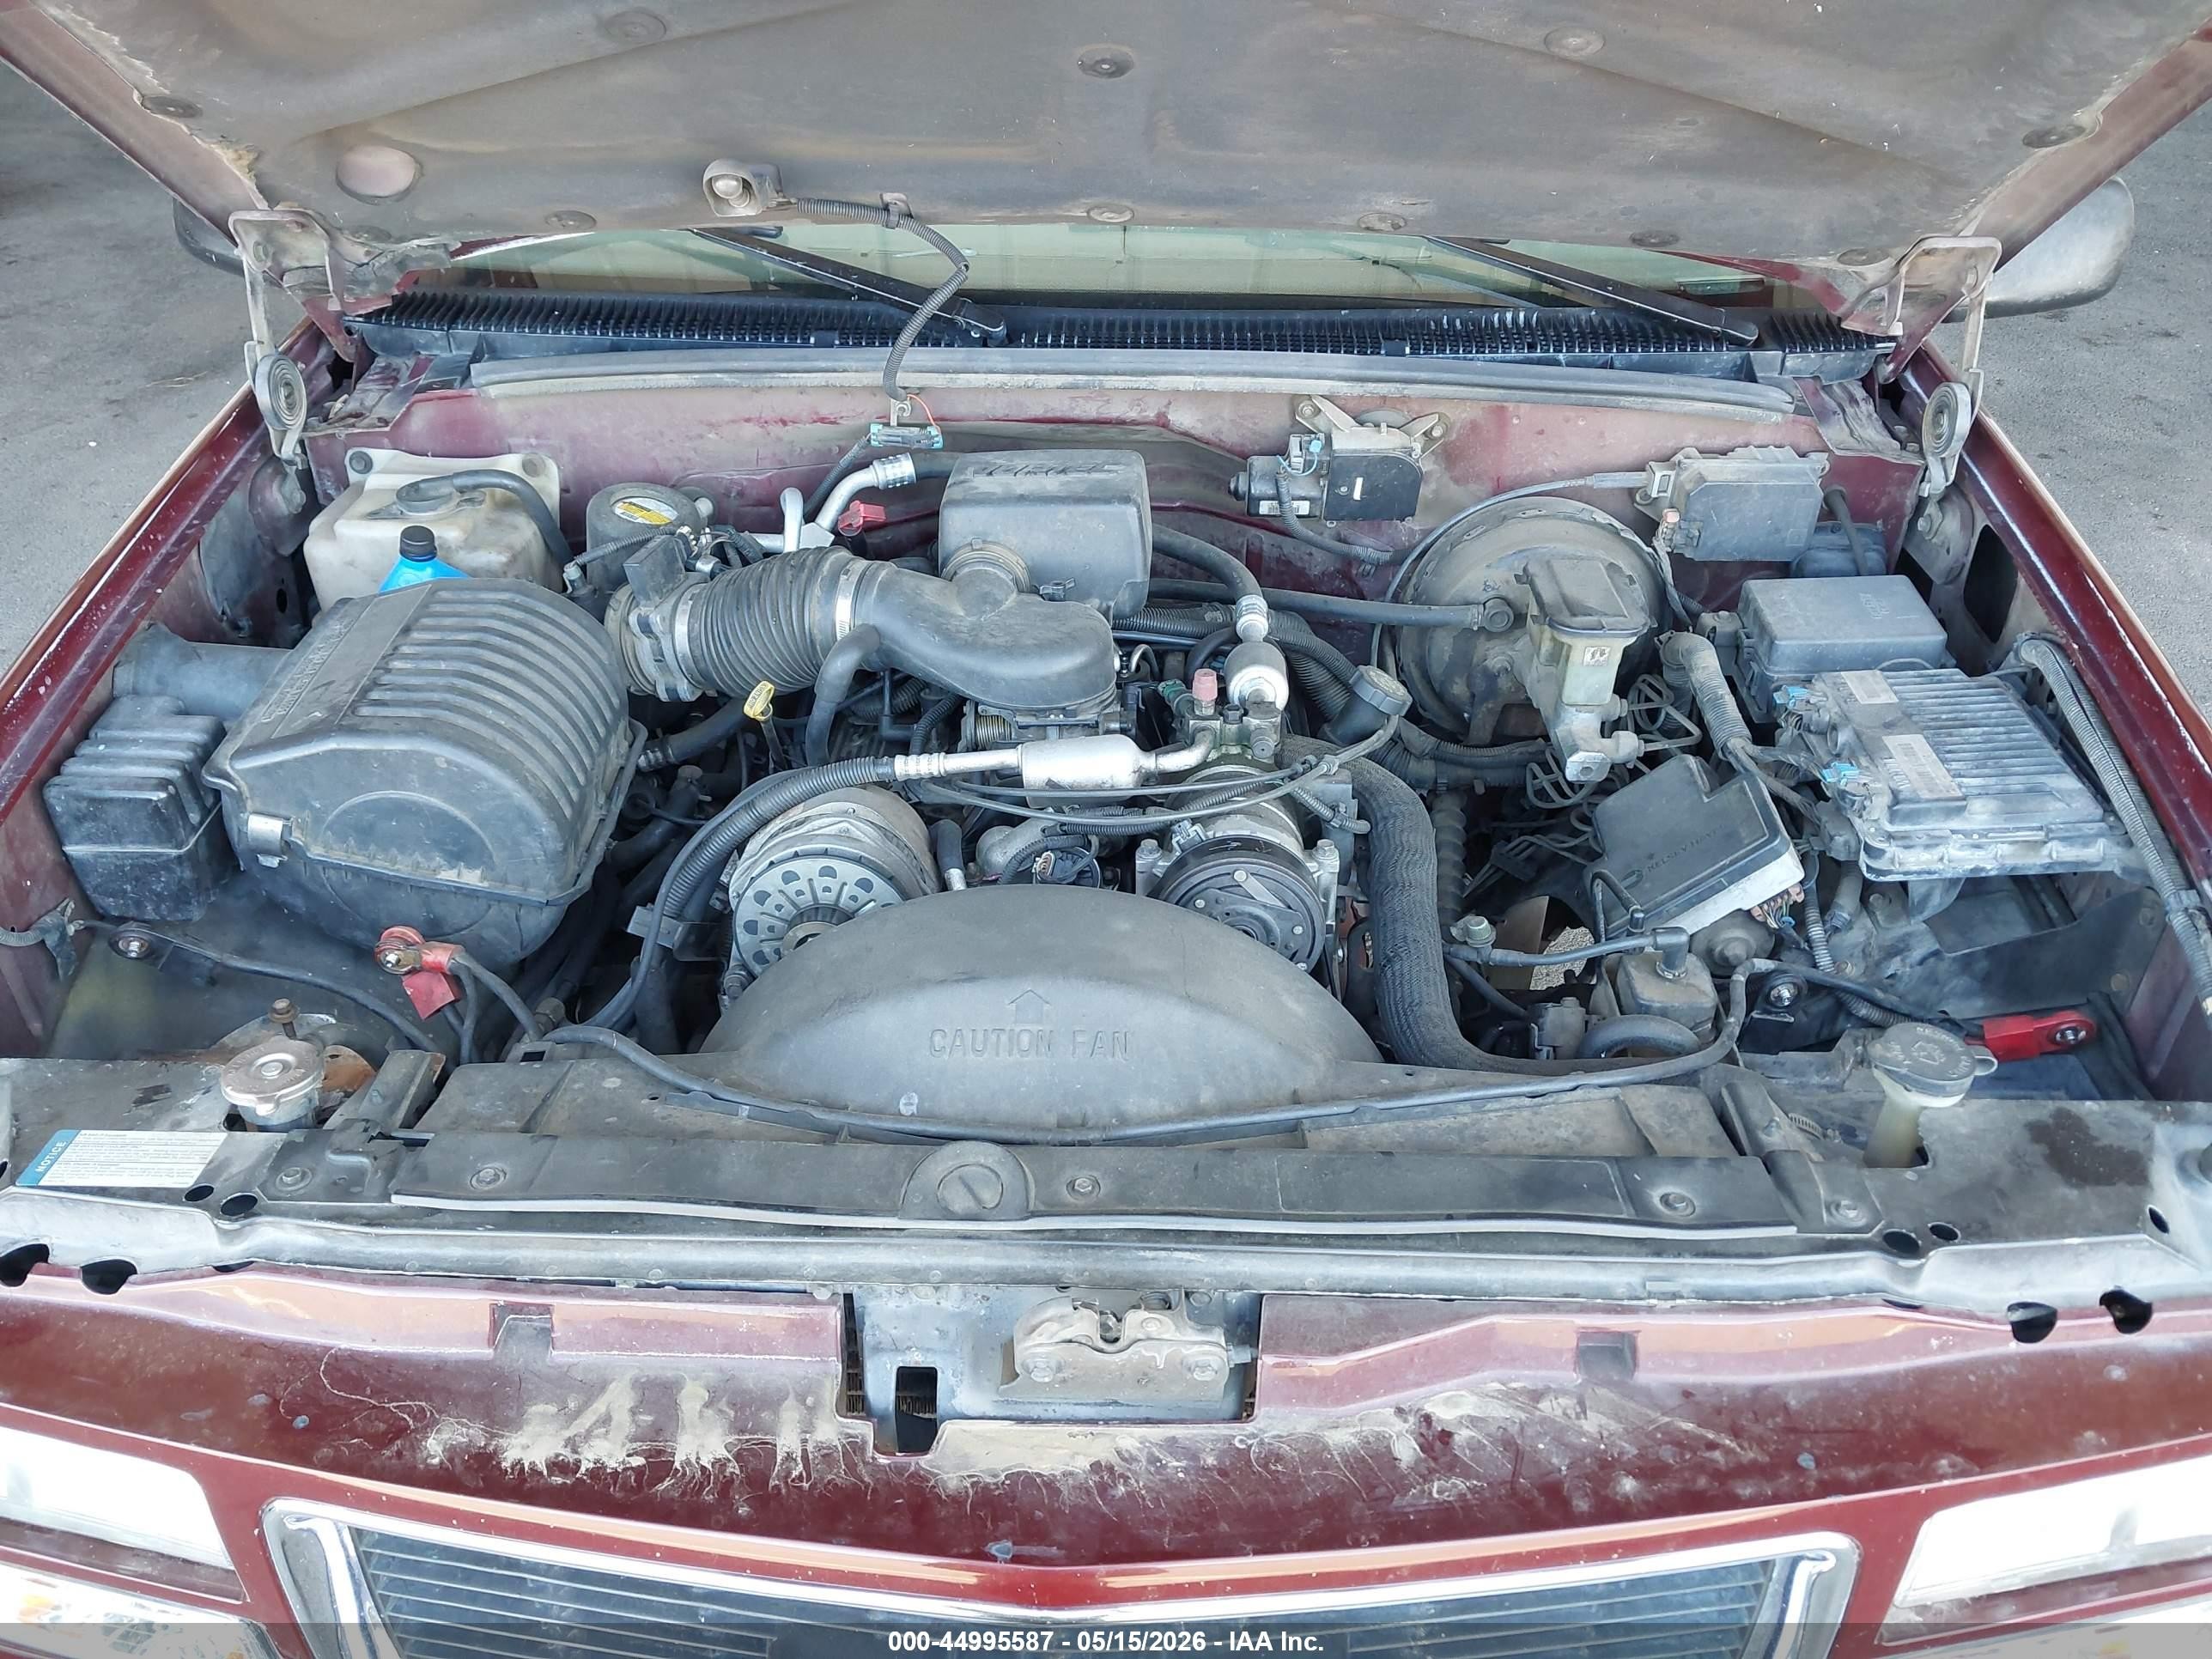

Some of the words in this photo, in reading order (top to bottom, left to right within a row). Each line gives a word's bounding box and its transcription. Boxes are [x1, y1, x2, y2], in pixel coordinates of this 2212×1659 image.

[929, 1028, 1054, 1058] CAUTION
[1071, 1030, 1133, 1061] FAN
[35, 1139, 67, 1173] NOTICE
